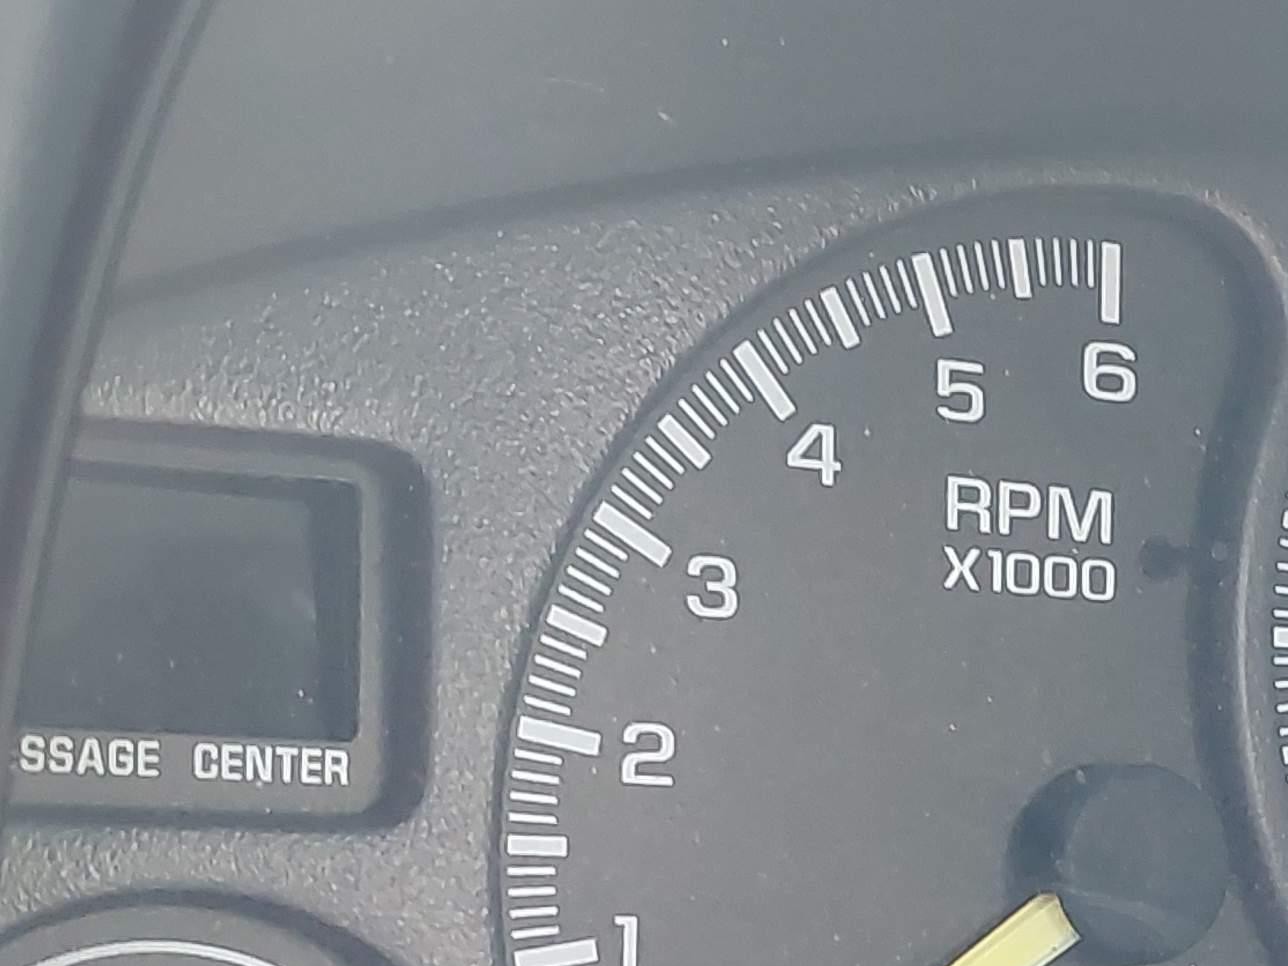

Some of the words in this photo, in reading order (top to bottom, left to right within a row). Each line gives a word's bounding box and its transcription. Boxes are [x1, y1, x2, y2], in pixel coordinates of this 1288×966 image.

[936, 359, 985, 422] 5
[1083, 342, 1137, 402] 6
[787, 424, 841, 486] 4
[946, 475, 1113, 544] RPM
[686, 556, 738, 619] 3
[943, 545, 1116, 602] X1000
[193, 743, 349, 785] CENTER
[621, 722, 675, 786] 2
